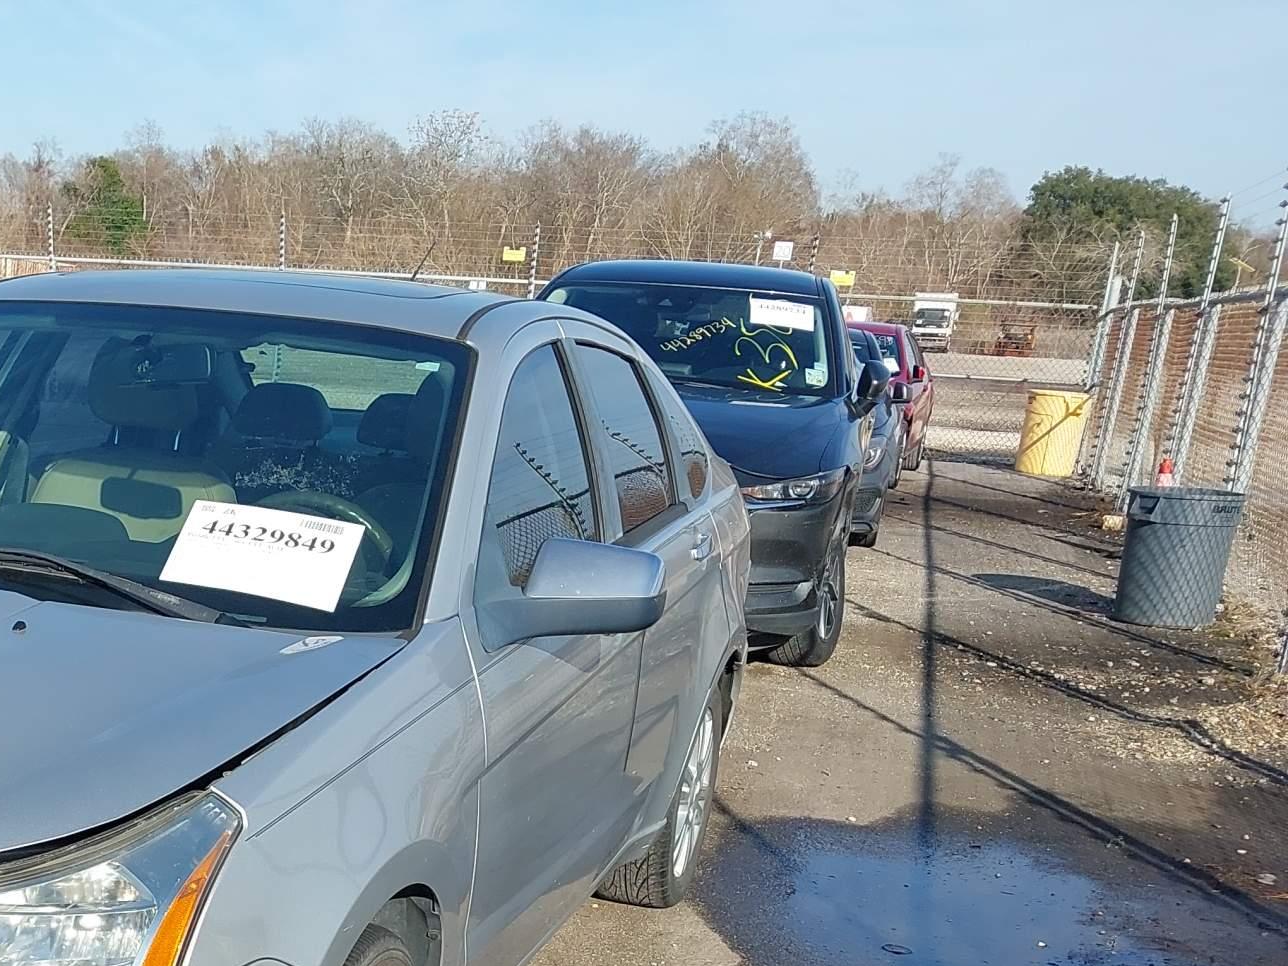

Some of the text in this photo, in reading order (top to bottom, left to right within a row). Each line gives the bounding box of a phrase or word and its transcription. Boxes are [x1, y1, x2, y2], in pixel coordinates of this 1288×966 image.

[775, 245, 791, 258] 20
[660, 316, 737, 352] 44289734
[202, 519, 335, 553] 44329849
